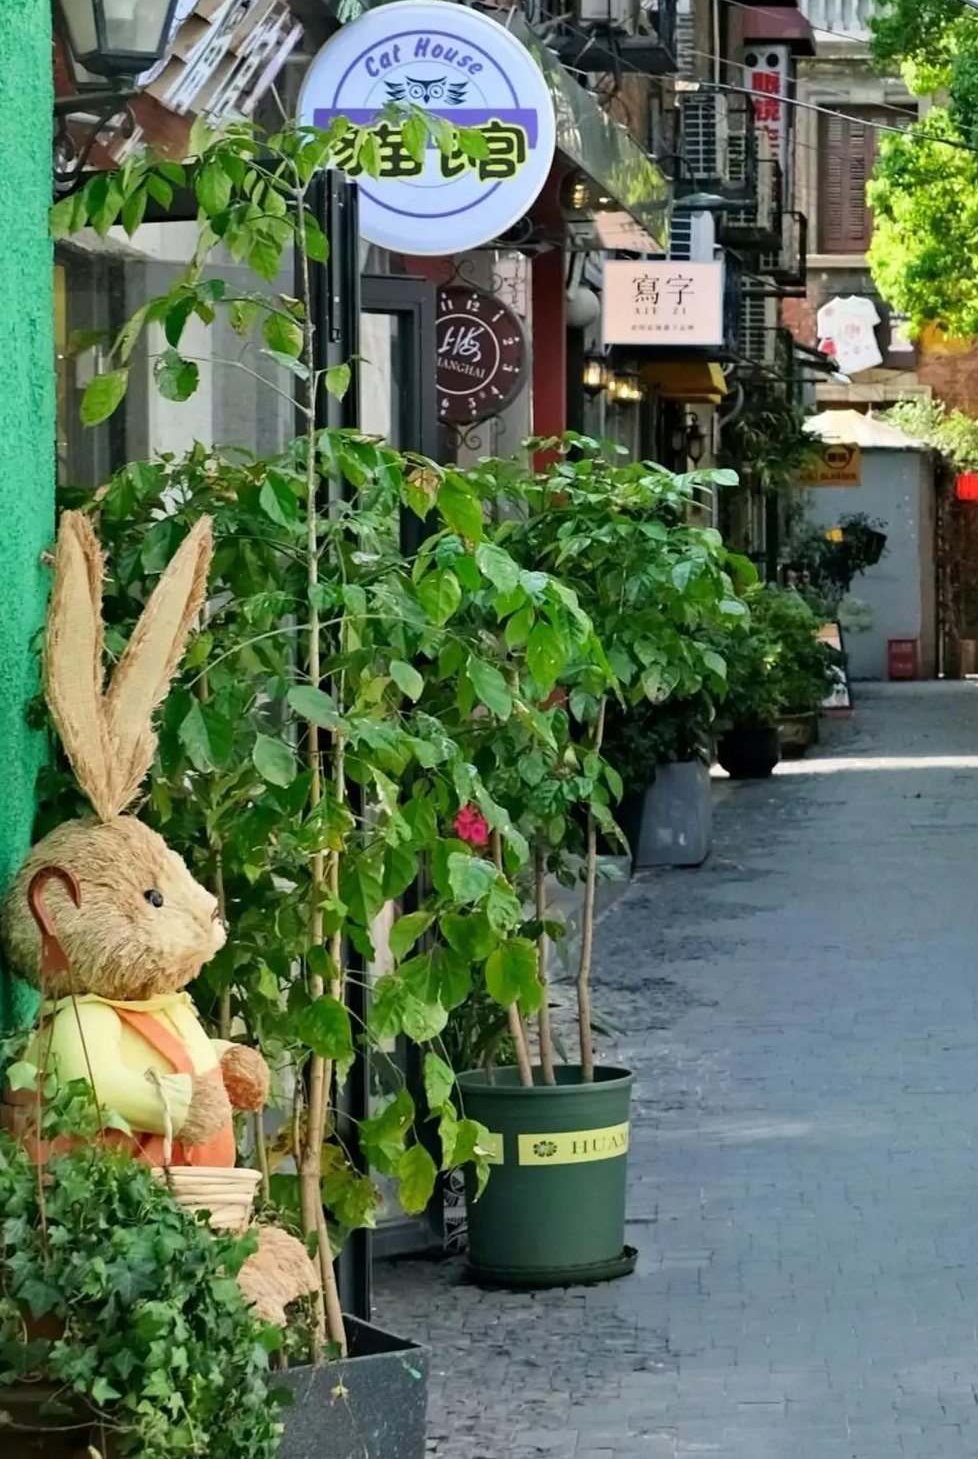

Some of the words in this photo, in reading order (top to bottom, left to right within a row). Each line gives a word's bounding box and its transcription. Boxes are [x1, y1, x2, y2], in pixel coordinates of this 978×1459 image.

[364, 44, 402, 78] Cat
[413, 37, 485, 77] House
[631, 273, 695, 306] 寫字
[437, 356, 487, 380] ANGHAI
